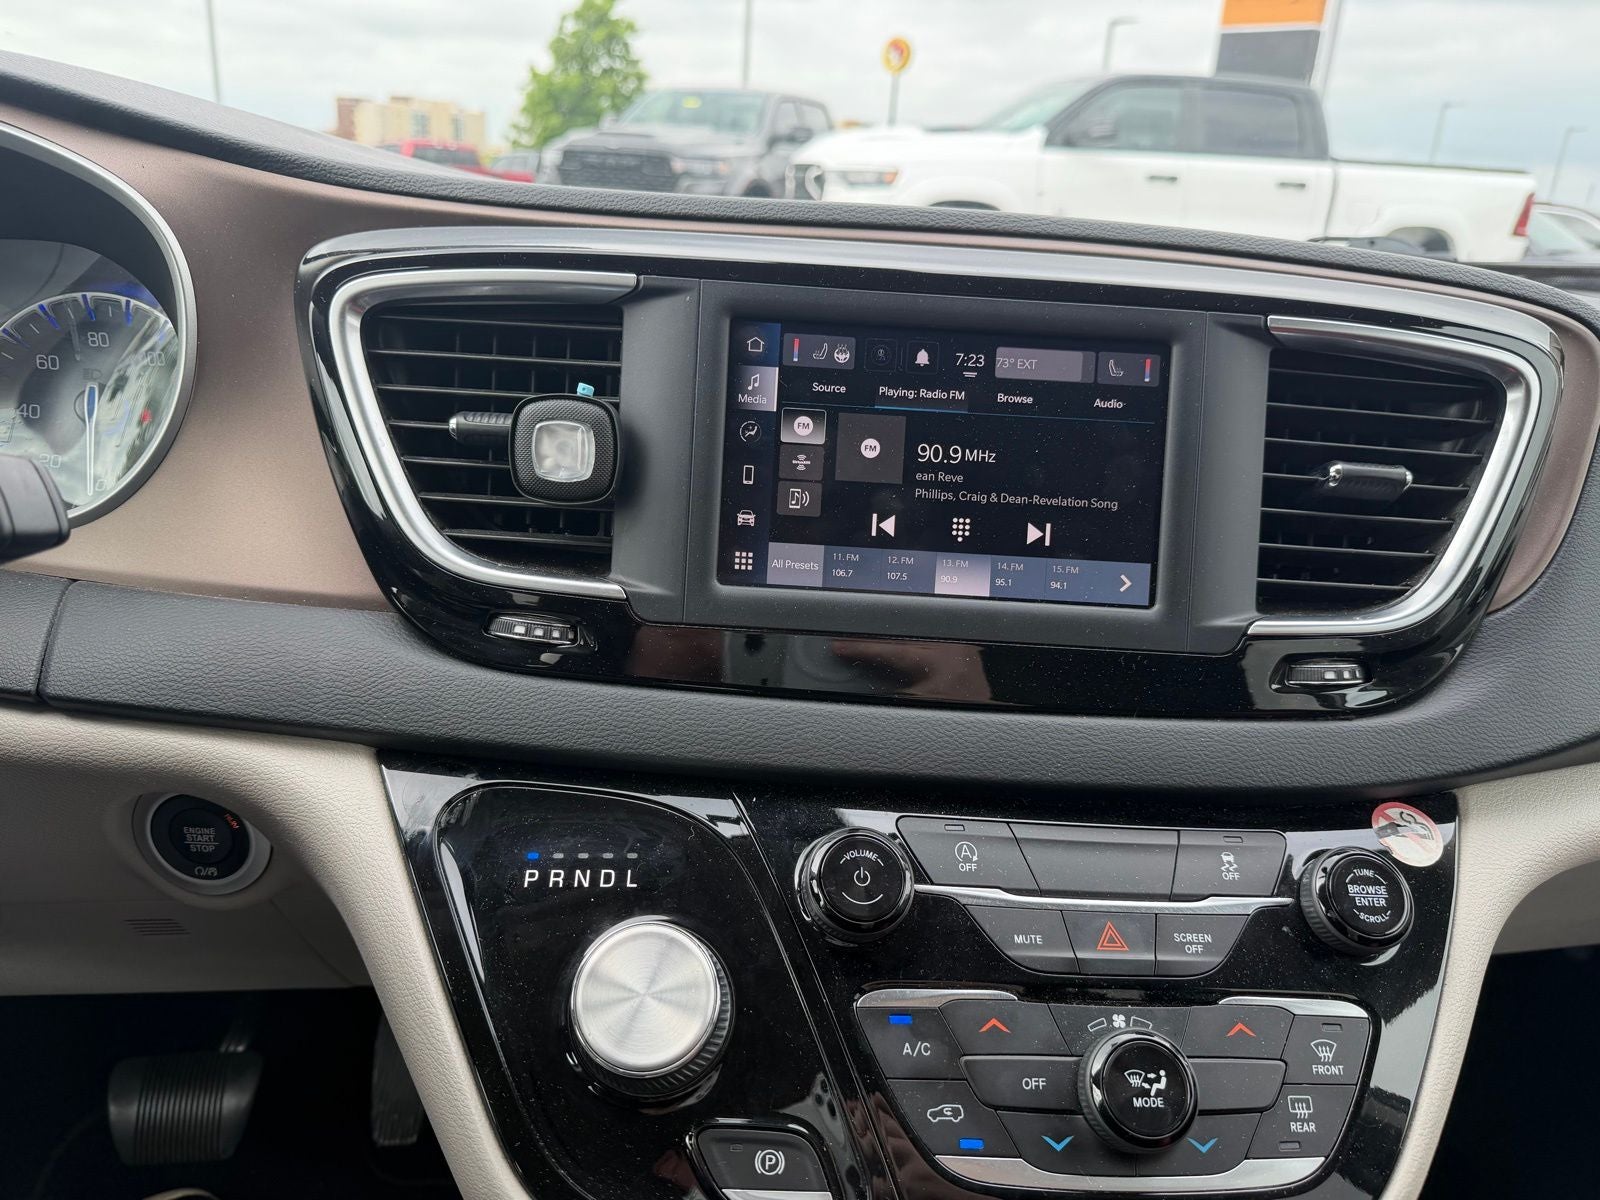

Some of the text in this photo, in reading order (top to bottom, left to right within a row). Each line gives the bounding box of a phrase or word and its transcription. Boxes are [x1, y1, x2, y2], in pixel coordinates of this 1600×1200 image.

[88, 332, 110, 347] 80
[36, 355, 59, 370] 60
[956, 353, 985, 367] 7:23
[1017, 360, 1038, 370] EXT
[812, 382, 846, 393] Source
[879, 386, 965, 400] Playing: Radio FM
[738, 394, 766, 404] Media
[997, 393, 1033, 404] Browse
[1094, 398, 1123, 409] Audio
[18, 404, 40, 418] 40
[797, 422, 810, 430] FM
[864, 444, 876, 452] FM
[917, 444, 996, 464] 90.9 MHz
[916, 472, 964, 483] ean Reve
[915, 488, 1118, 511] Phillips, Craig & Dean-Revelation Song
[834, 552, 859, 562] 11. FM
[888, 556, 914, 565] 12. FM
[772, 560, 818, 570] All Presets
[943, 560, 968, 568] 13. FM
[998, 562, 1024, 572] 14. FM
[832, 569, 852, 578] 106.7
[1052, 566, 1078, 574] 15. FM
[888, 572, 908, 580] 107.5
[940, 576, 958, 584] 90.9
[996, 578, 1012, 587] 95.1
[1050, 582, 1068, 590] 94.1
[186, 834, 214, 842] START
[844, 850, 878, 862] VOLUME
[959, 864, 978, 872] OFF
[1222, 872, 1240, 880] OFF
[1353, 869, 1374, 878] TUNE
[1348, 884, 1388, 894] BROWSE
[1356, 897, 1386, 906] ENTER
[1359, 912, 1390, 923] SCROLL
[1014, 934, 1042, 944] MUTE
[1174, 932, 1212, 943] SCREEN
[1185, 945, 1204, 954] OFF
[902, 1042, 930, 1057] A/C
[1312, 1064, 1344, 1075] FRONT
[1022, 1078, 1046, 1090] OFF
[1133, 1097, 1164, 1108] MODE
[1290, 1122, 1316, 1132] REAR
